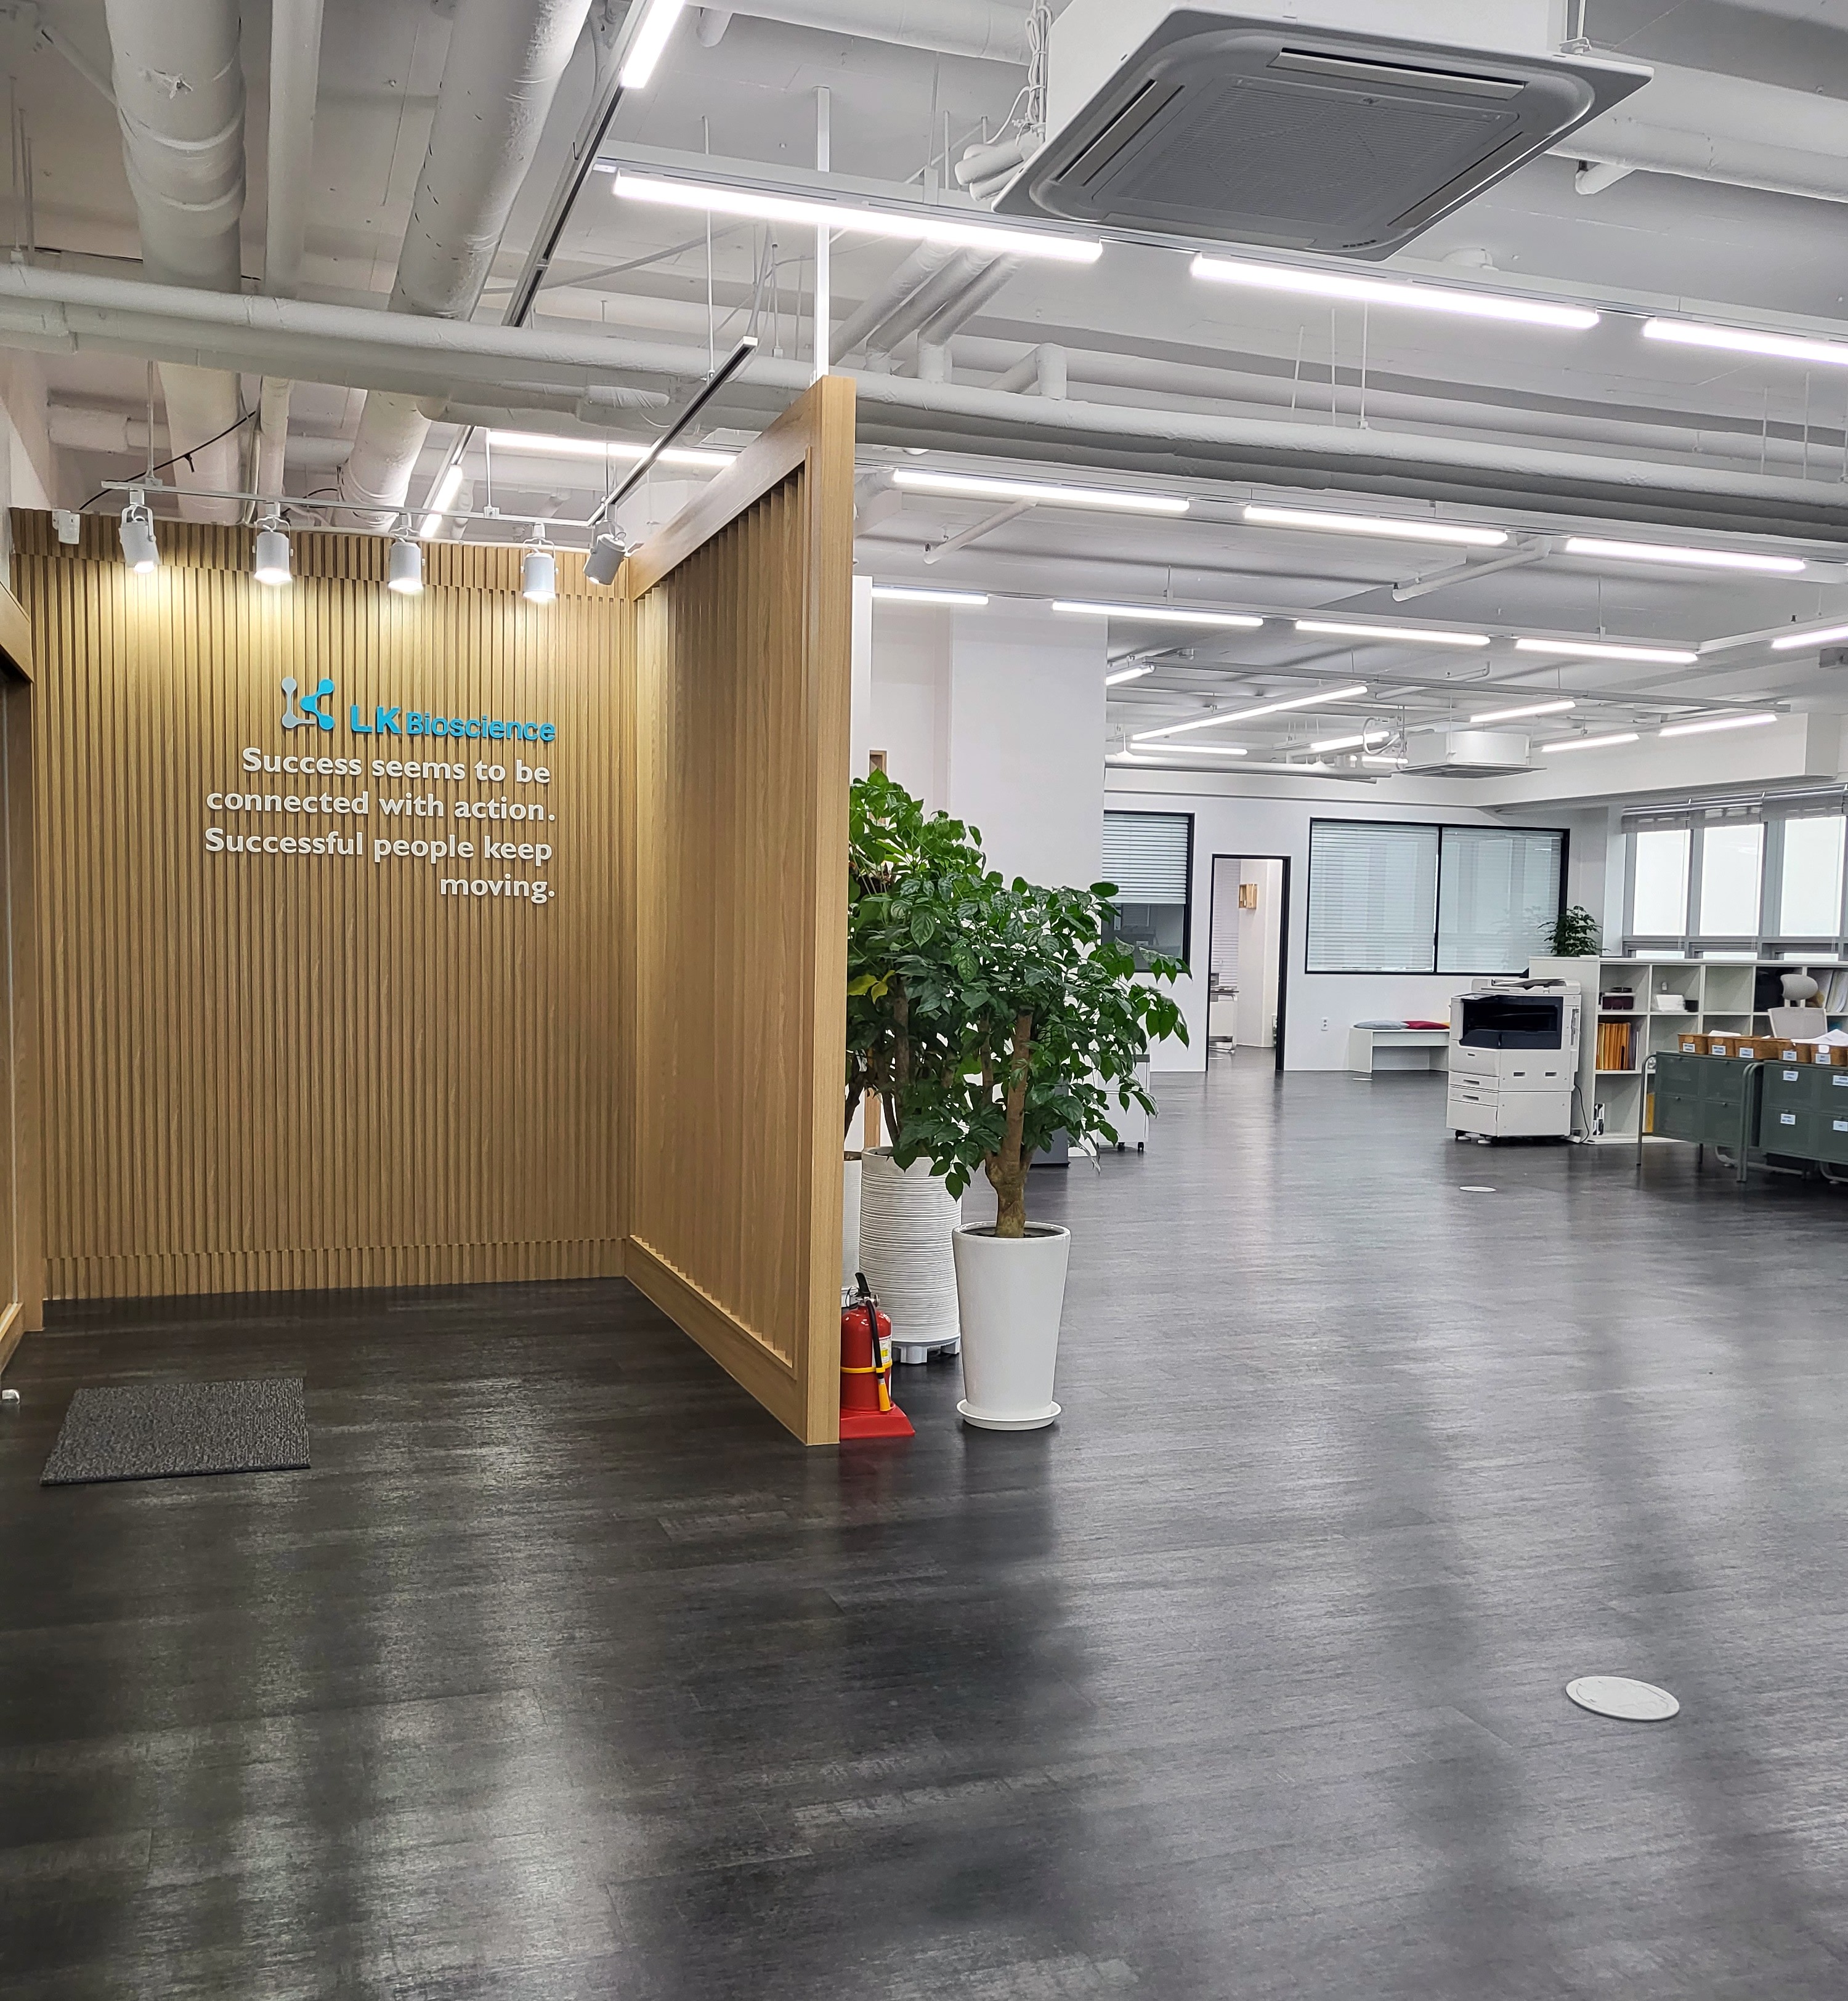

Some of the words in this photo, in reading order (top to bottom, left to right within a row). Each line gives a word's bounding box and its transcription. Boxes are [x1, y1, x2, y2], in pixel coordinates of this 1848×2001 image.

[242, 747, 362, 776] Success
[371, 759, 466, 780] seems
[474, 759, 506, 782] to
[516, 759, 551, 784] be
[206, 791, 369, 815] connected
[379, 792, 444, 817] with
[453, 796, 556, 821] action.
[205, 828, 363, 855] Successful
[373, 834, 474, 864] people
[484, 836, 553, 867] keep
[440, 873, 556, 904] moving.
